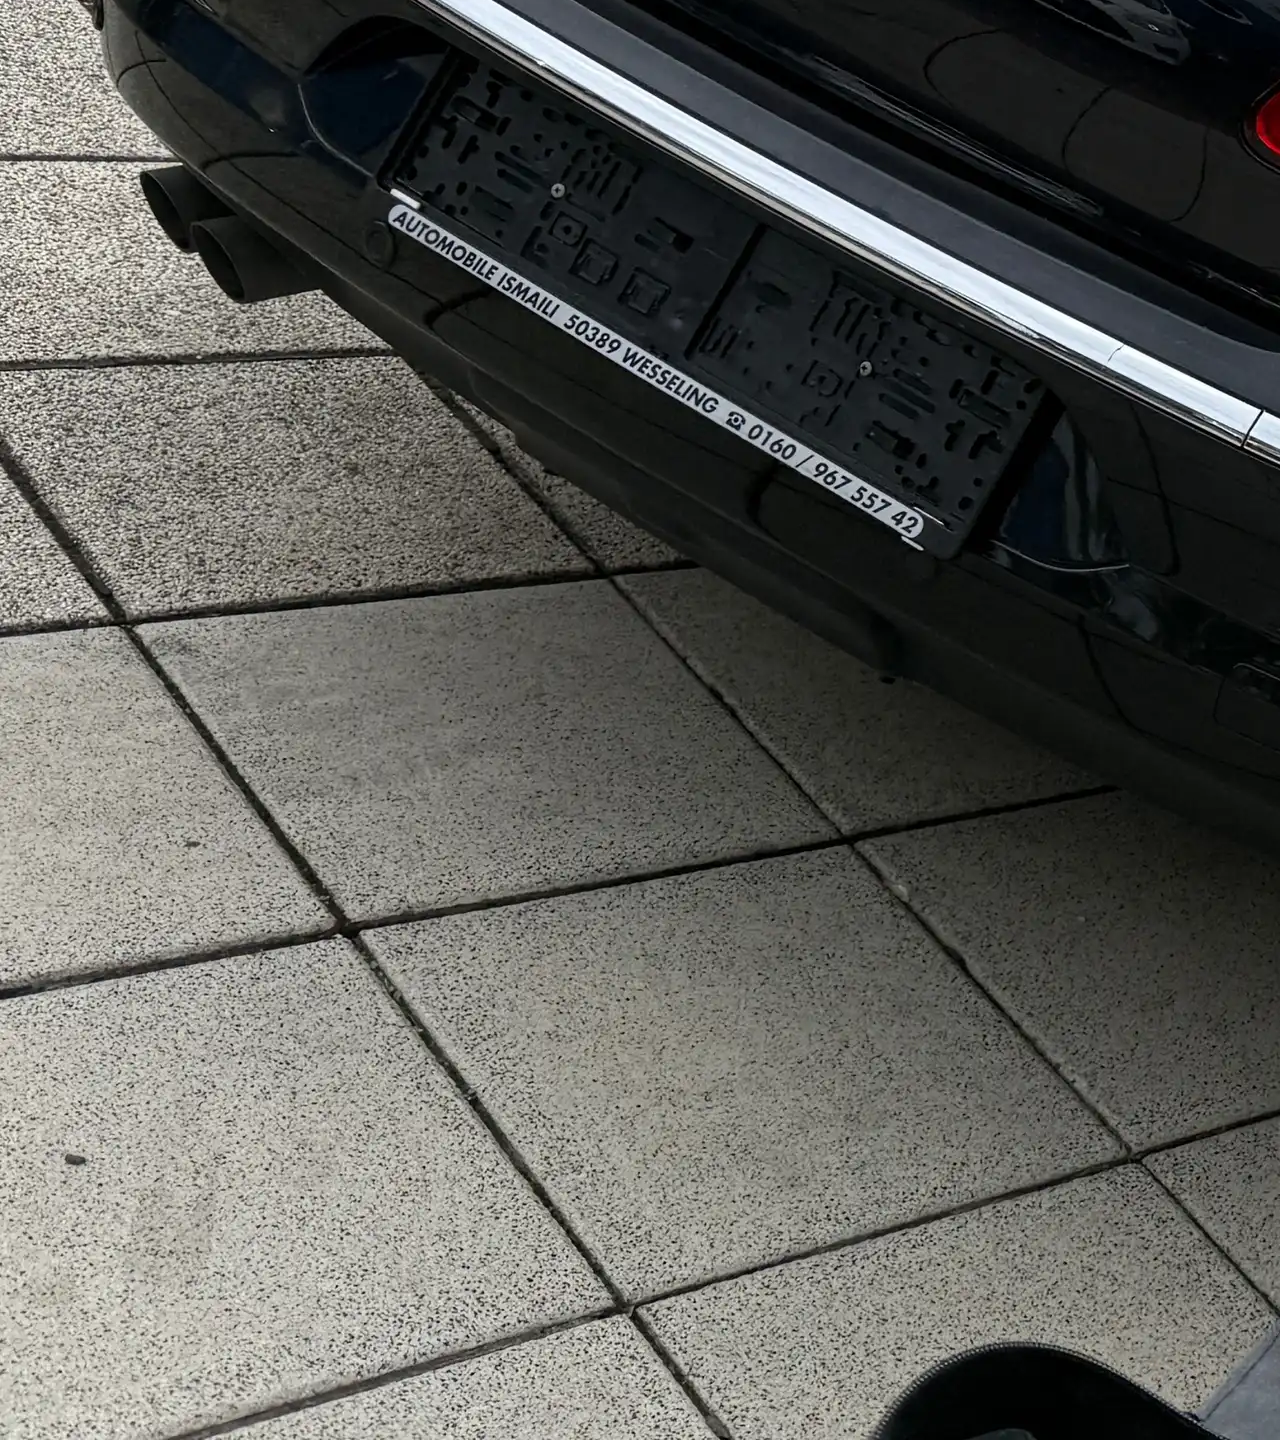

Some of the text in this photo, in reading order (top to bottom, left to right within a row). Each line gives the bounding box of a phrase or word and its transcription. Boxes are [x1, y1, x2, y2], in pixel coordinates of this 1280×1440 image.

[392, 211, 499, 281] AUTOMOBILE
[497, 272, 560, 318] ISMAILI
[563, 314, 622, 354] 50389
[622, 346, 720, 414] WESSELING
[749, 424, 797, 461] 0160
[815, 462, 851, 491] 967
[851, 486, 892, 514] 557
[891, 510, 919, 534] 42
